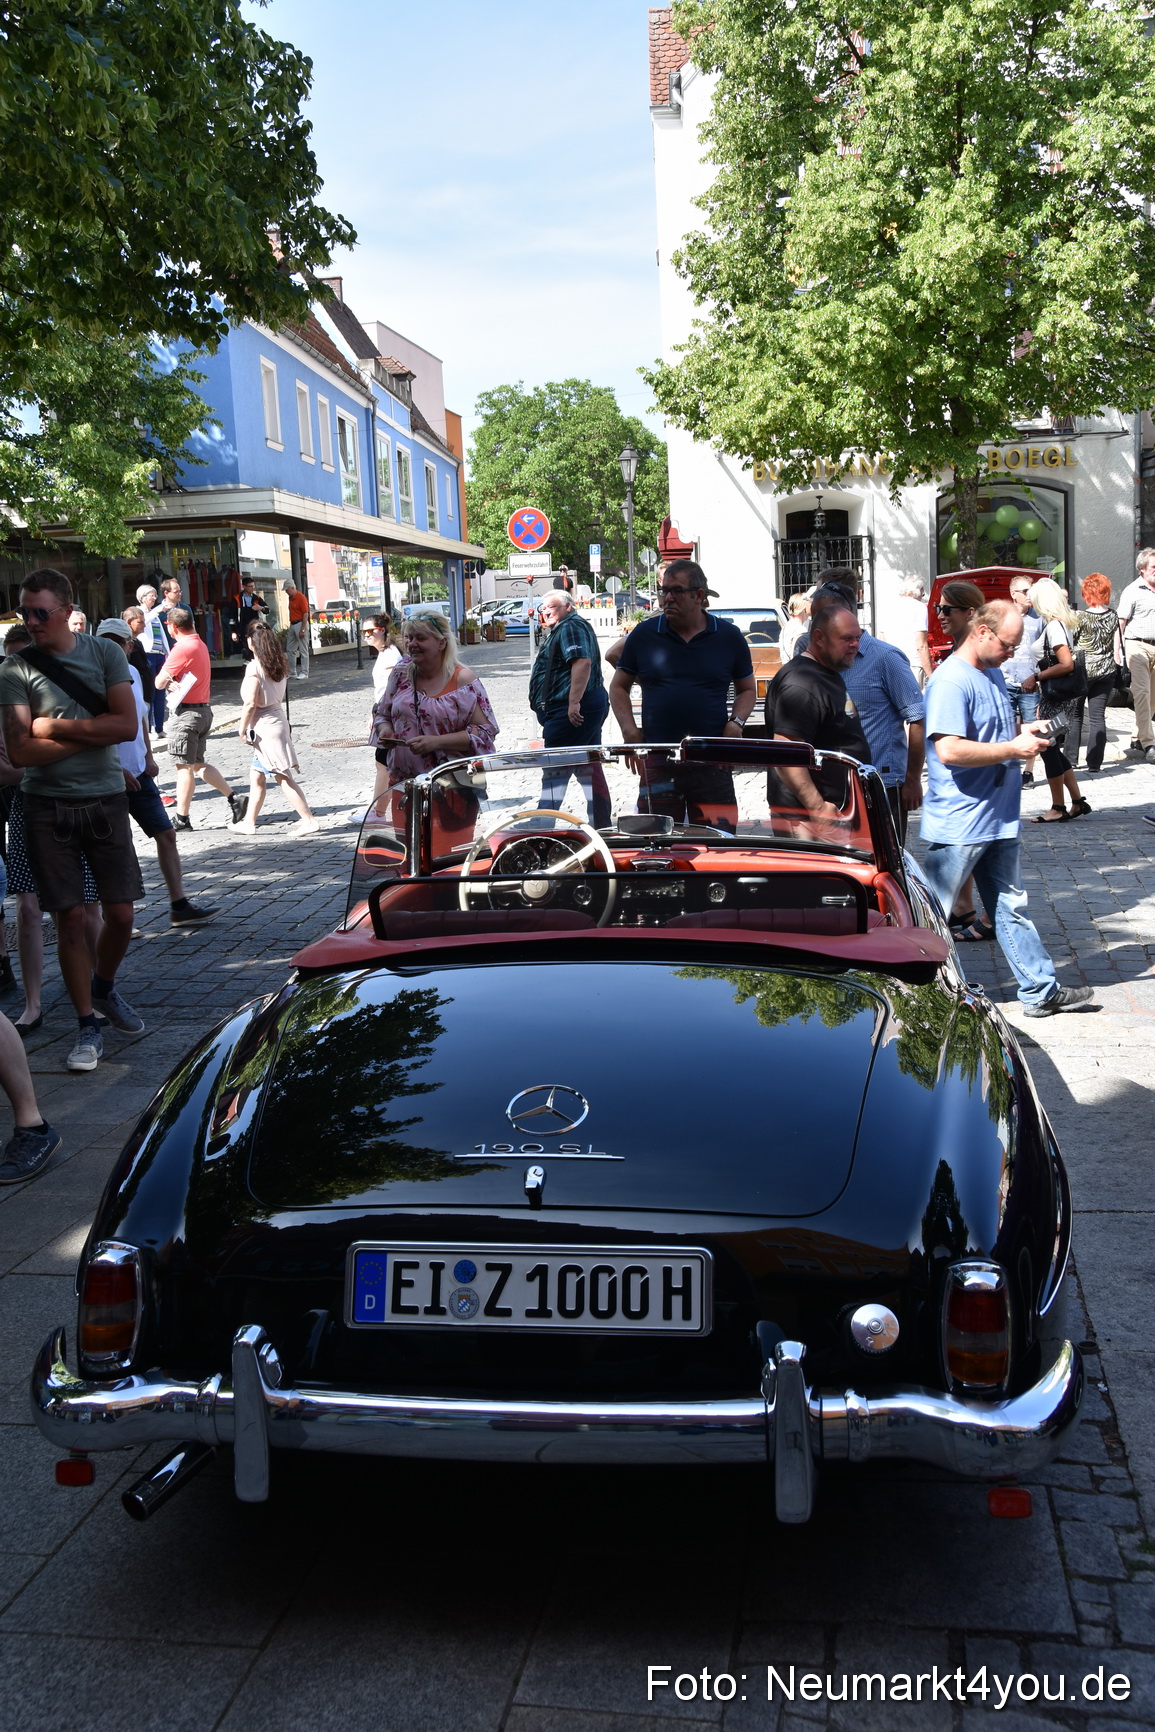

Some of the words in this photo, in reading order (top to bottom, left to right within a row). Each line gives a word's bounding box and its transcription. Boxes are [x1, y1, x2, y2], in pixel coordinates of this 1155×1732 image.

[987, 445, 1079, 470] BOEGL
[474, 1143, 544, 1154] 190
[558, 1143, 607, 1155] SL
[364, 1294, 376, 1310] D
